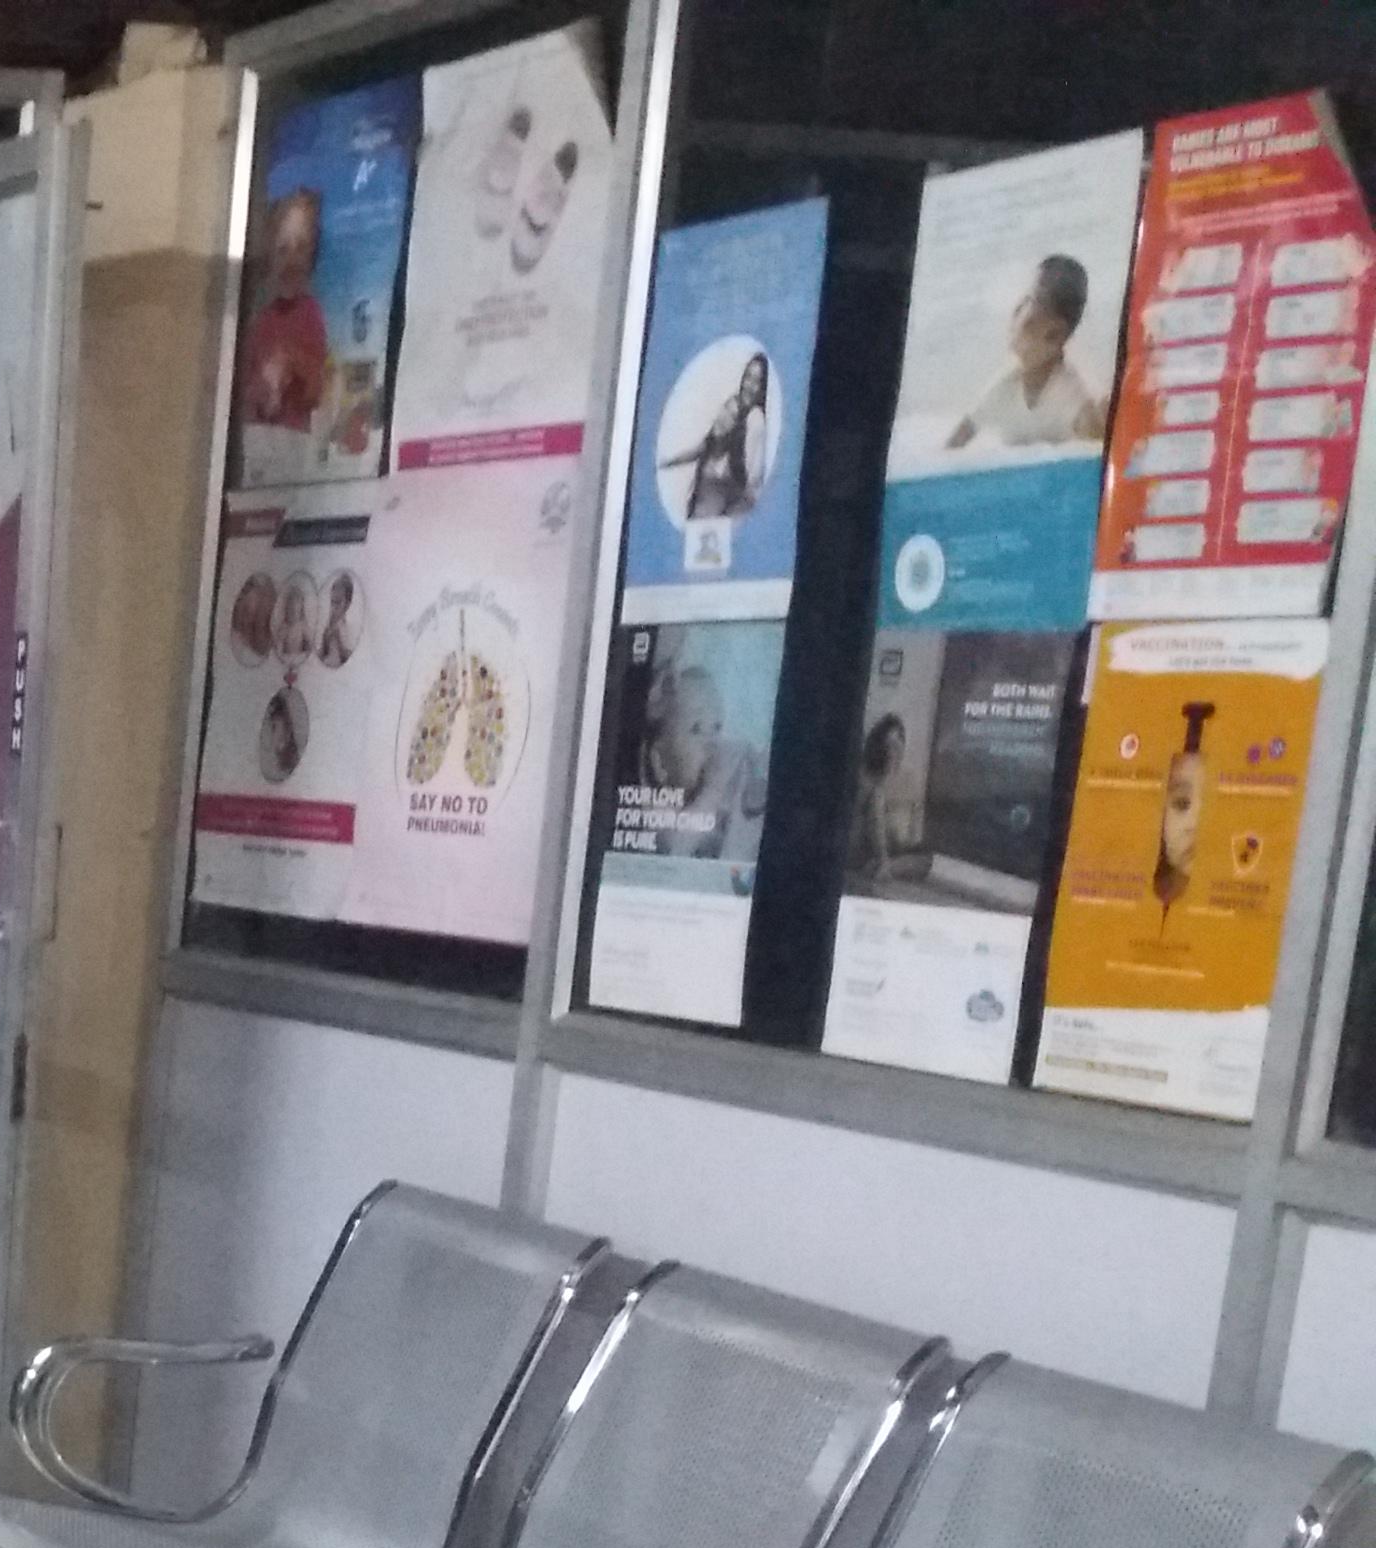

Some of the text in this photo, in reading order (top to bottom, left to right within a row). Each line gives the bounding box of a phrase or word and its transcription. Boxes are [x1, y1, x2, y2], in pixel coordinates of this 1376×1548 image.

[11, 638, 27, 750] PUSH
[409, 792, 488, 815] SAY NO TO
[618, 785, 685, 807] YOUR LOVE
[615, 807, 717, 832] FOR YOUR CHILD
[613, 829, 624, 848] IS
